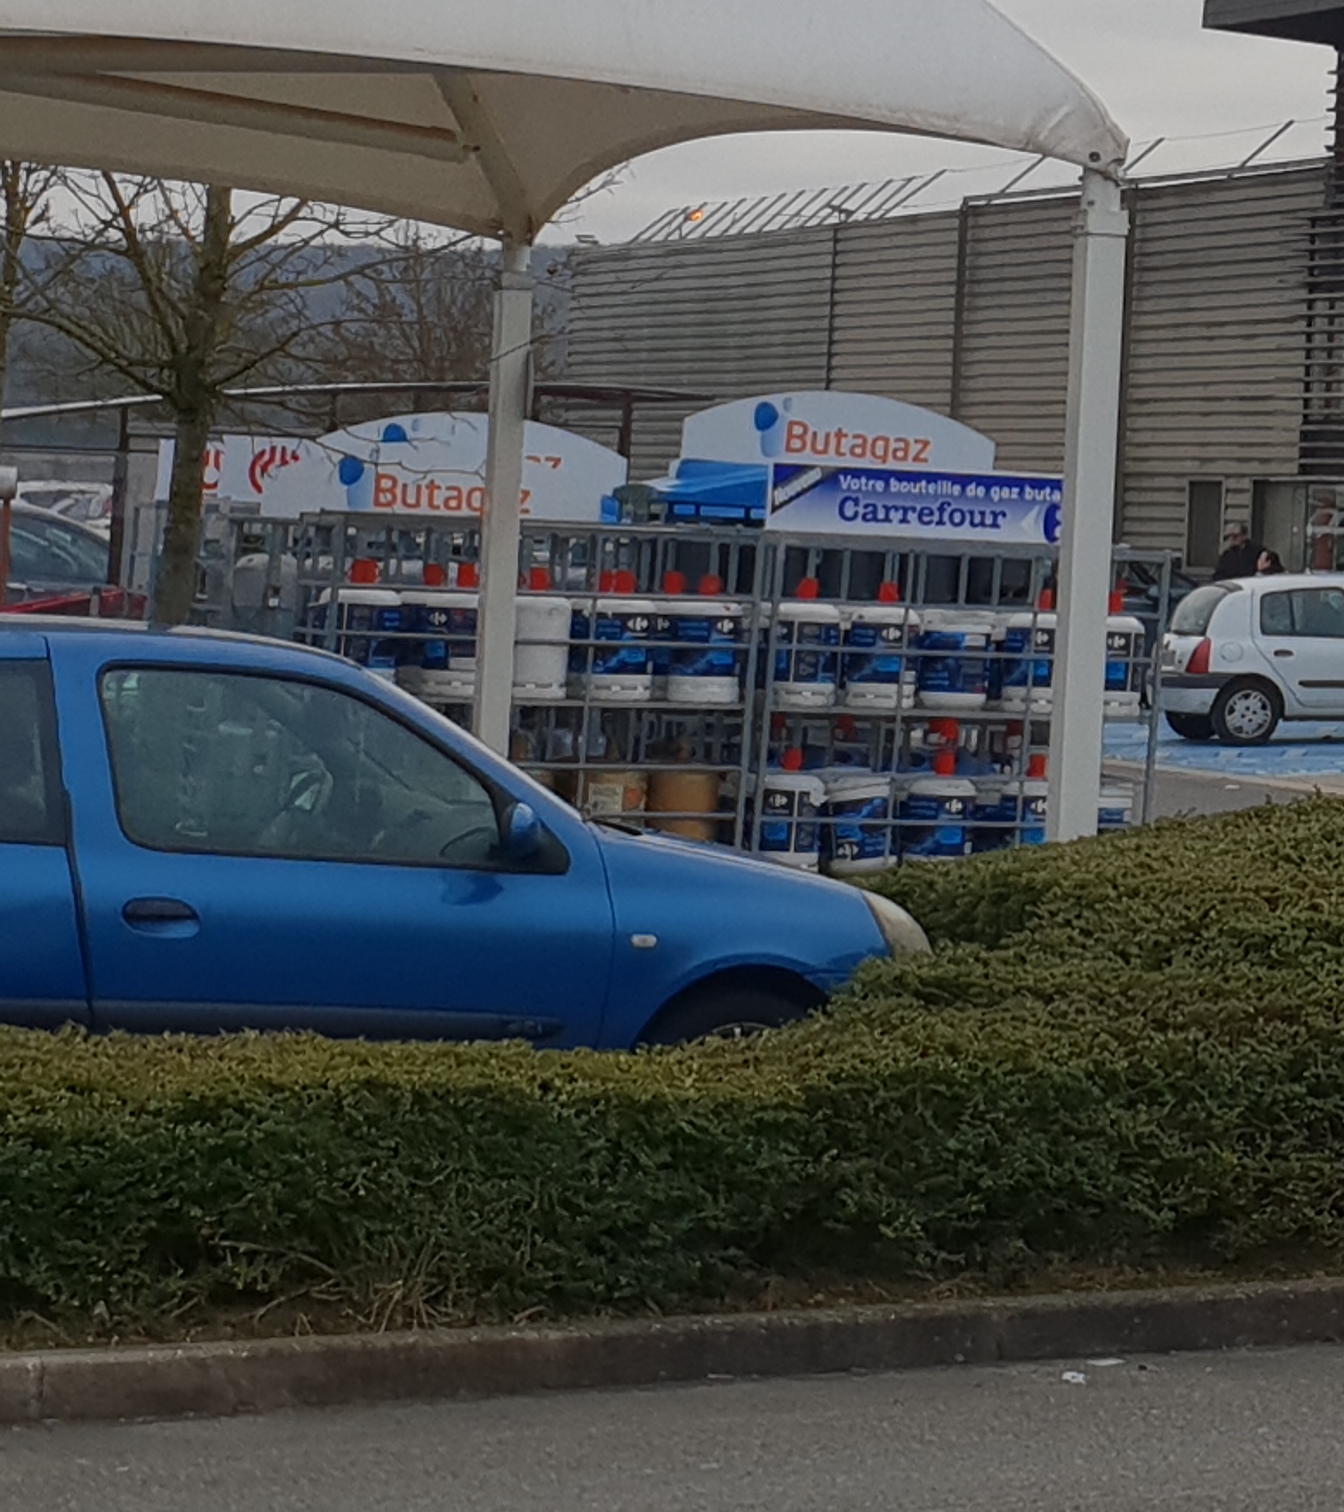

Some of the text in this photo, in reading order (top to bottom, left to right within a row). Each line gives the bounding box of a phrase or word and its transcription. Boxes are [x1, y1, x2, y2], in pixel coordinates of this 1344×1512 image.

[784, 420, 931, 464] Butagaz
[839, 474, 885, 493] Votre
[889, 477, 962, 496] bouteille
[966, 481, 986, 500] de
[990, 486, 1020, 503] gaz
[838, 495, 1007, 529] Carrefour
